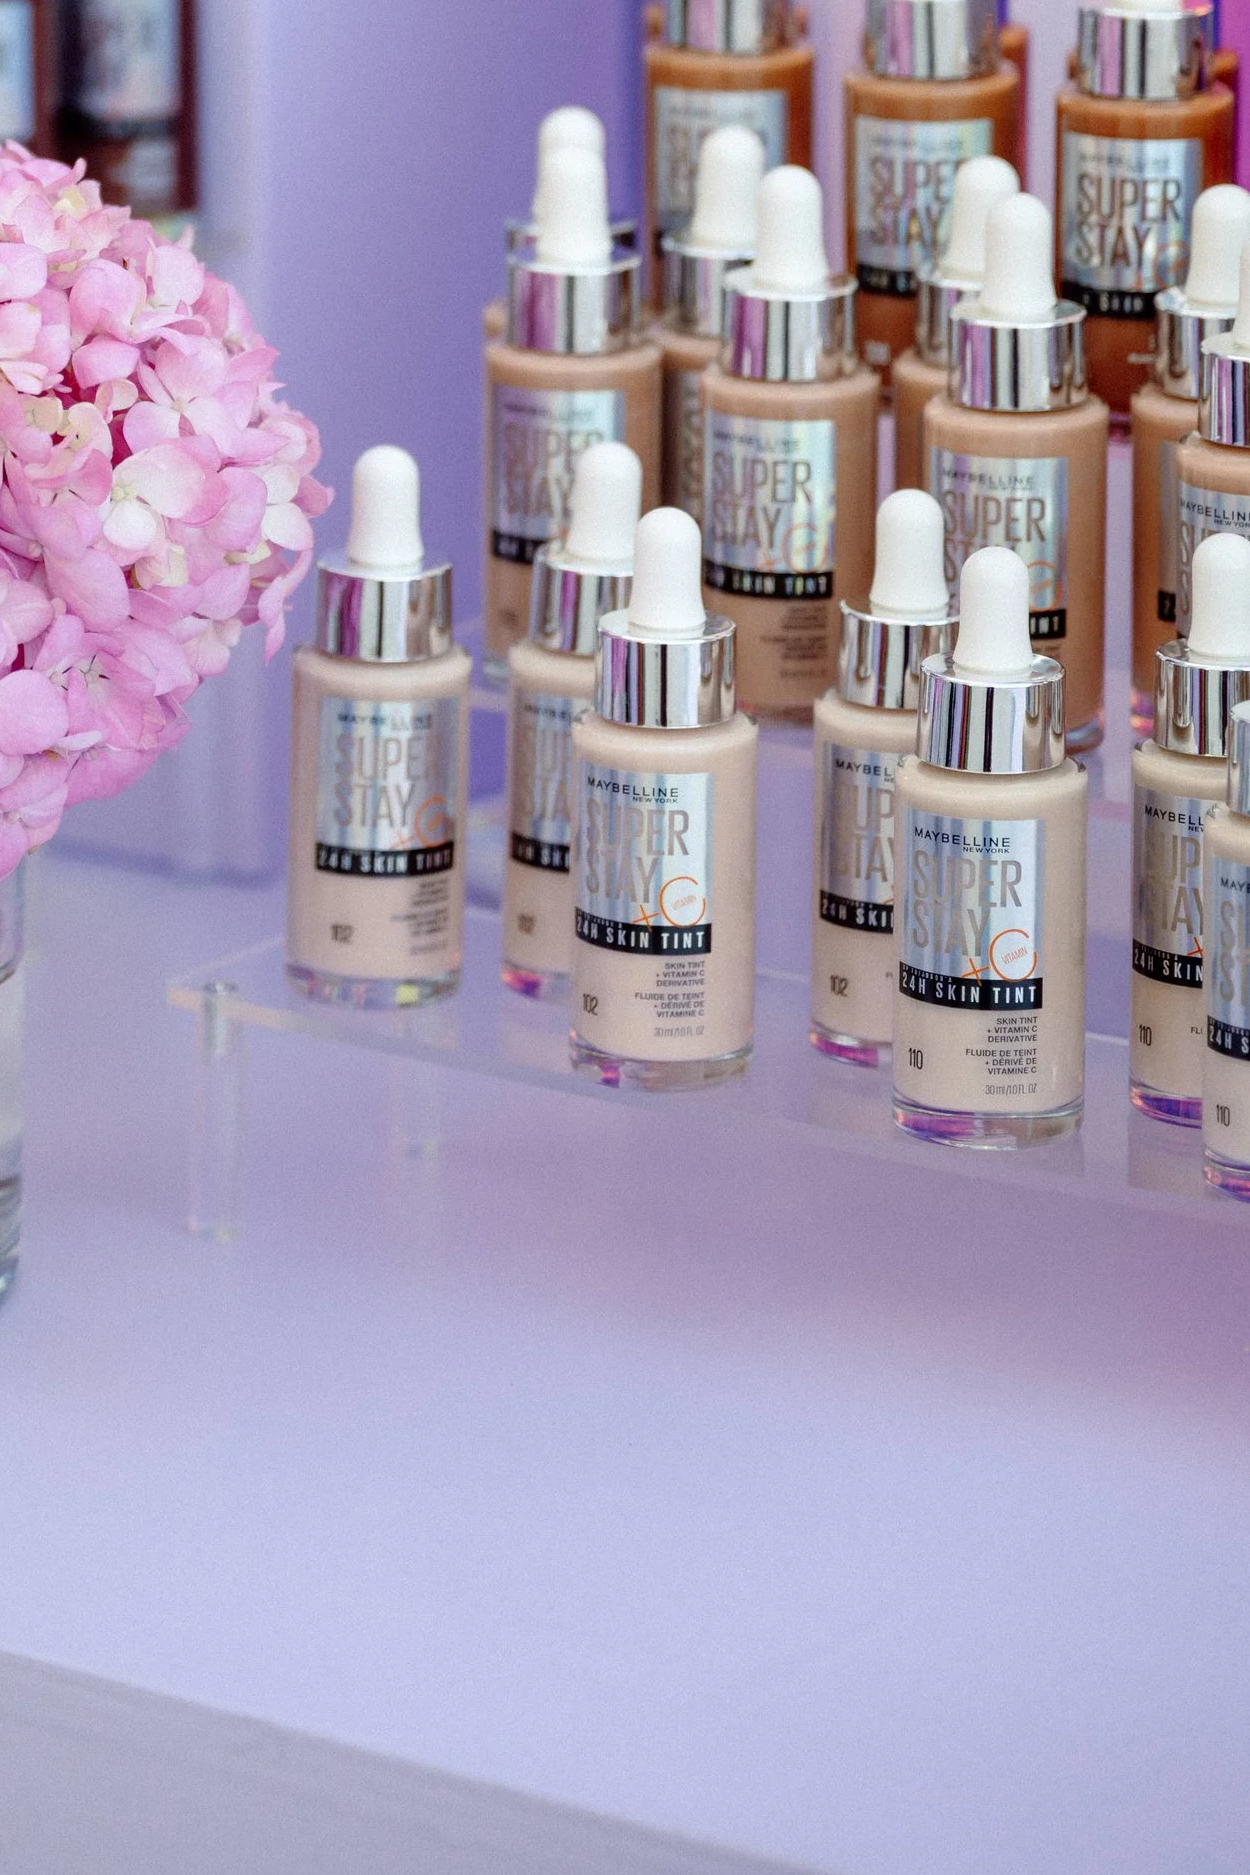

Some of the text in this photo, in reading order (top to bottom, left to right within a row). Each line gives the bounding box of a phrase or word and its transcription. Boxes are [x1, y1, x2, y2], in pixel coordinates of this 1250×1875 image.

[1076, 173, 1181, 223] SUPER
[1075, 218, 1154, 268] STAY
[713, 452, 812, 504] SUPER
[713, 497, 782, 550] STAY
[943, 490, 1047, 543] SUPER
[835, 758, 893, 777] MAYBEL
[587, 776, 679, 798] MAYBELLINE
[334, 780, 415, 828] STAY
[586, 797, 690, 856] SUPER
[914, 826, 1011, 847] MAYBELLINE
[360, 854, 408, 874] SKIN
[835, 831, 894, 883] STA
[586, 847, 659, 903] STAY
[913, 850, 1022, 908] SUPER
[855, 908, 893, 928] SKI
[913, 899, 991, 957] STAY
[576, 916, 598, 940] 24H
[606, 928, 649, 949] SKIN
[661, 931, 705, 949] TINT
[665, 962, 685, 970] SKIN
[1001, 946, 1028, 965] VITAMIN
[1134, 947, 1154, 972] 24H
[1162, 959, 1204, 982] SKIN
[656, 978, 705, 987] DERIVATIVE
[662, 970, 697, 978] VITAMIN
[634, 992, 664, 1000] FLUIDE
[667, 992, 679, 1000] DE
[830, 975, 848, 997] 102
[902, 971, 1037, 1004] 24H SKIN TINT
[583, 993, 599, 1016] 102
[656, 1010, 696, 1018] VITAMINE
[693, 1000, 704, 1008] DE
[996, 1017, 1017, 1025] SKIN
[987, 1035, 1037, 1043] DERIVATIVE
[1138, 1024, 1152, 1047] 110
[1209, 1027, 1233, 1051] 24H
[908, 1047, 924, 1070] 110
[965, 1049, 997, 1057] FLUIDE
[999, 1049, 1011, 1057] DE
[992, 1056, 1023, 1066] DÉRIVÉ
[1026, 1057, 1037, 1065] DE
[1216, 1104, 1231, 1126] 110
